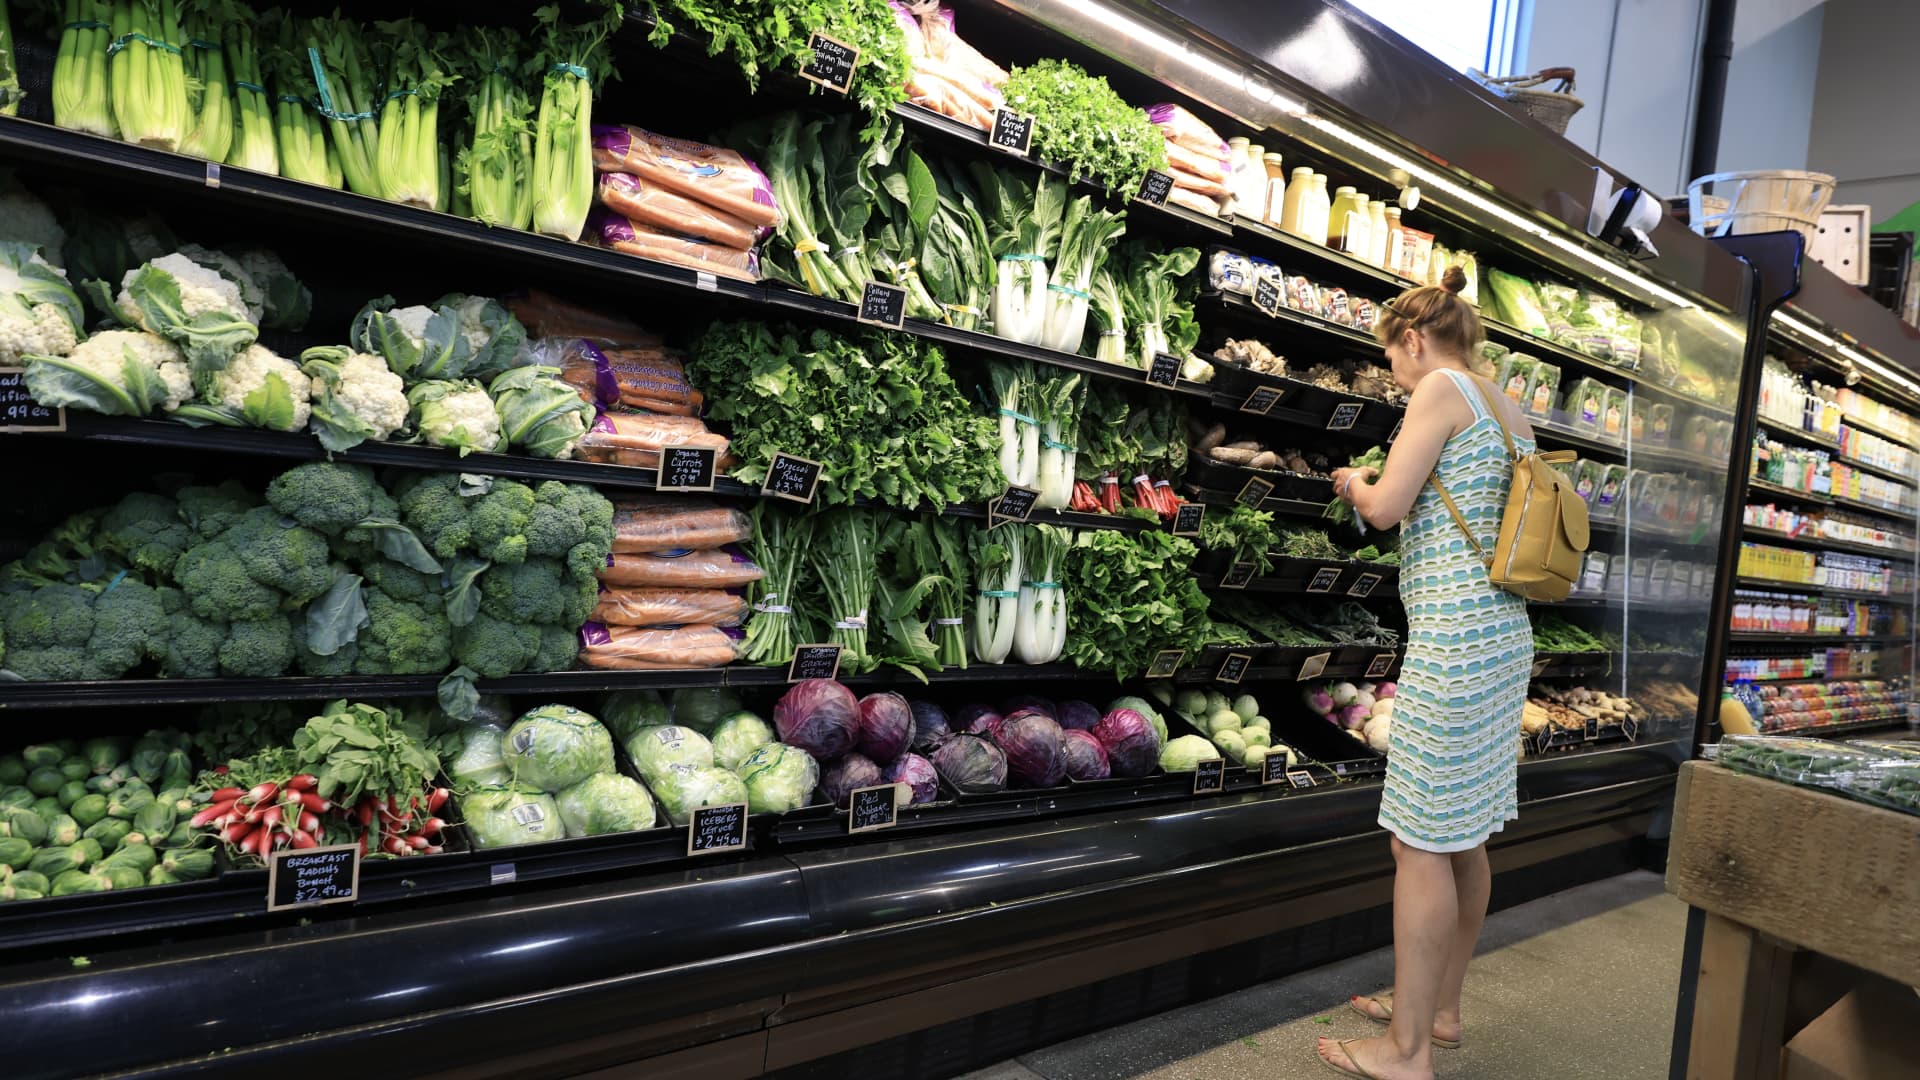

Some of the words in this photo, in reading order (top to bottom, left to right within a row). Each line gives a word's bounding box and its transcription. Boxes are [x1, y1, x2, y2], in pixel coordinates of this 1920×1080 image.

[671, 457, 703, 468] Carrots
[776, 458, 809, 474] Broccoli
[781, 470, 804, 483] Rabe
[861, 791, 879, 805] Red
[856, 803, 889, 817] Cabbage
[700, 814, 738, 826] ICEBERG
[702, 823, 735, 836] LETTUCE
[286, 853, 350, 868] BREAKFAST
